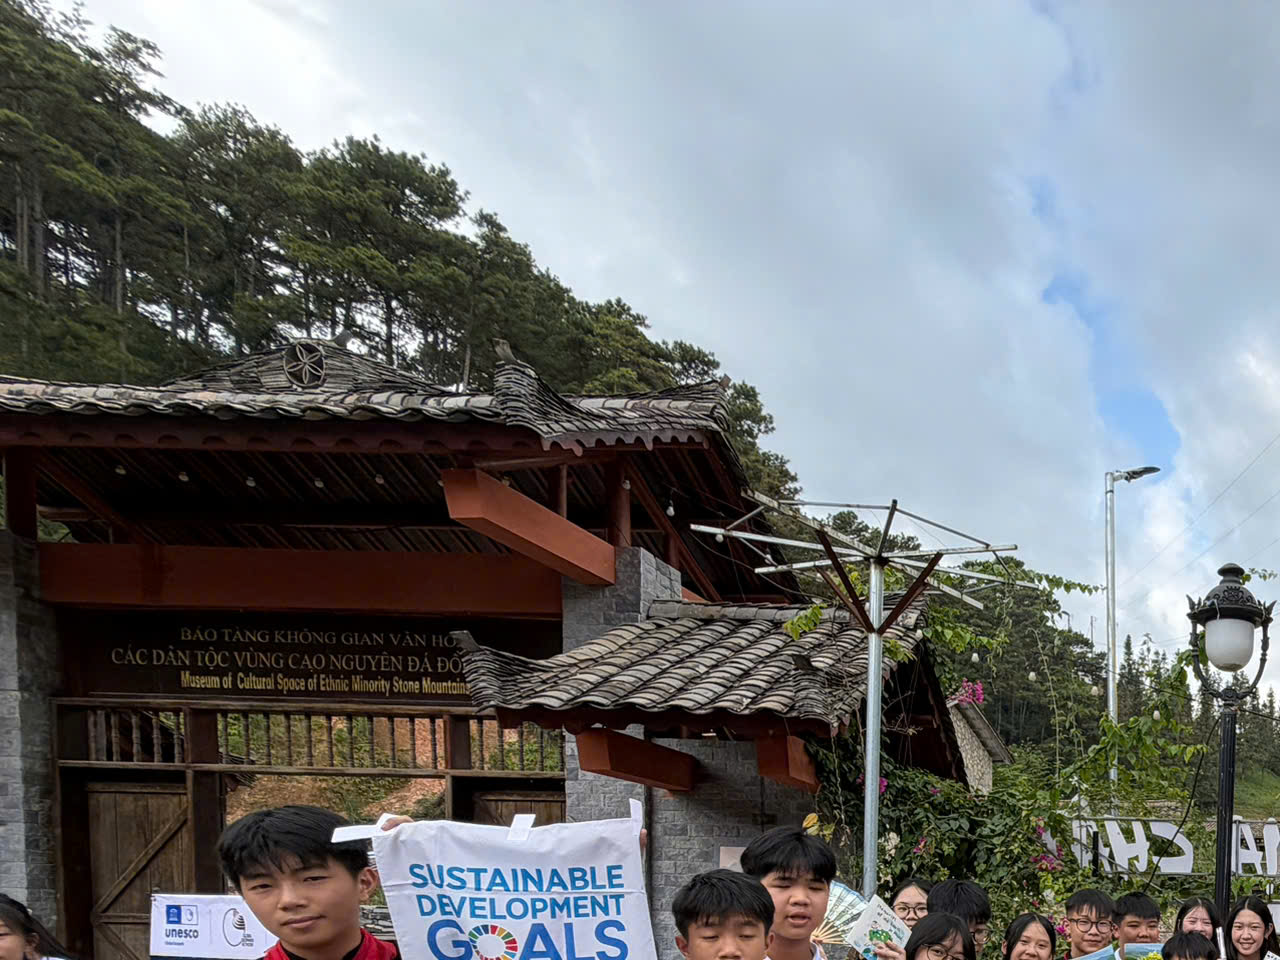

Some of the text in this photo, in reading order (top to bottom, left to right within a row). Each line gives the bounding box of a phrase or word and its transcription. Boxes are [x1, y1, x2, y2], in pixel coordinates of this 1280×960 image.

[341, 632, 384, 645] GIAN
[111, 645, 149, 665] CÁC
[194, 647, 230, 670] TỘC
[234, 647, 284, 669] VÙNG
[288, 653, 326, 670] CAO
[329, 651, 402, 672] NGUYÊN
[408, 653, 432, 672] ĐÁ
[181, 670, 472, 697] Museum of Cultural Space of Ethnic Minority Stone Mountains
[408, 863, 625, 892] SUSTAINABLE
[415, 893, 625, 920] DEVELOPMENT
[165, 928, 199, 939] unesco
